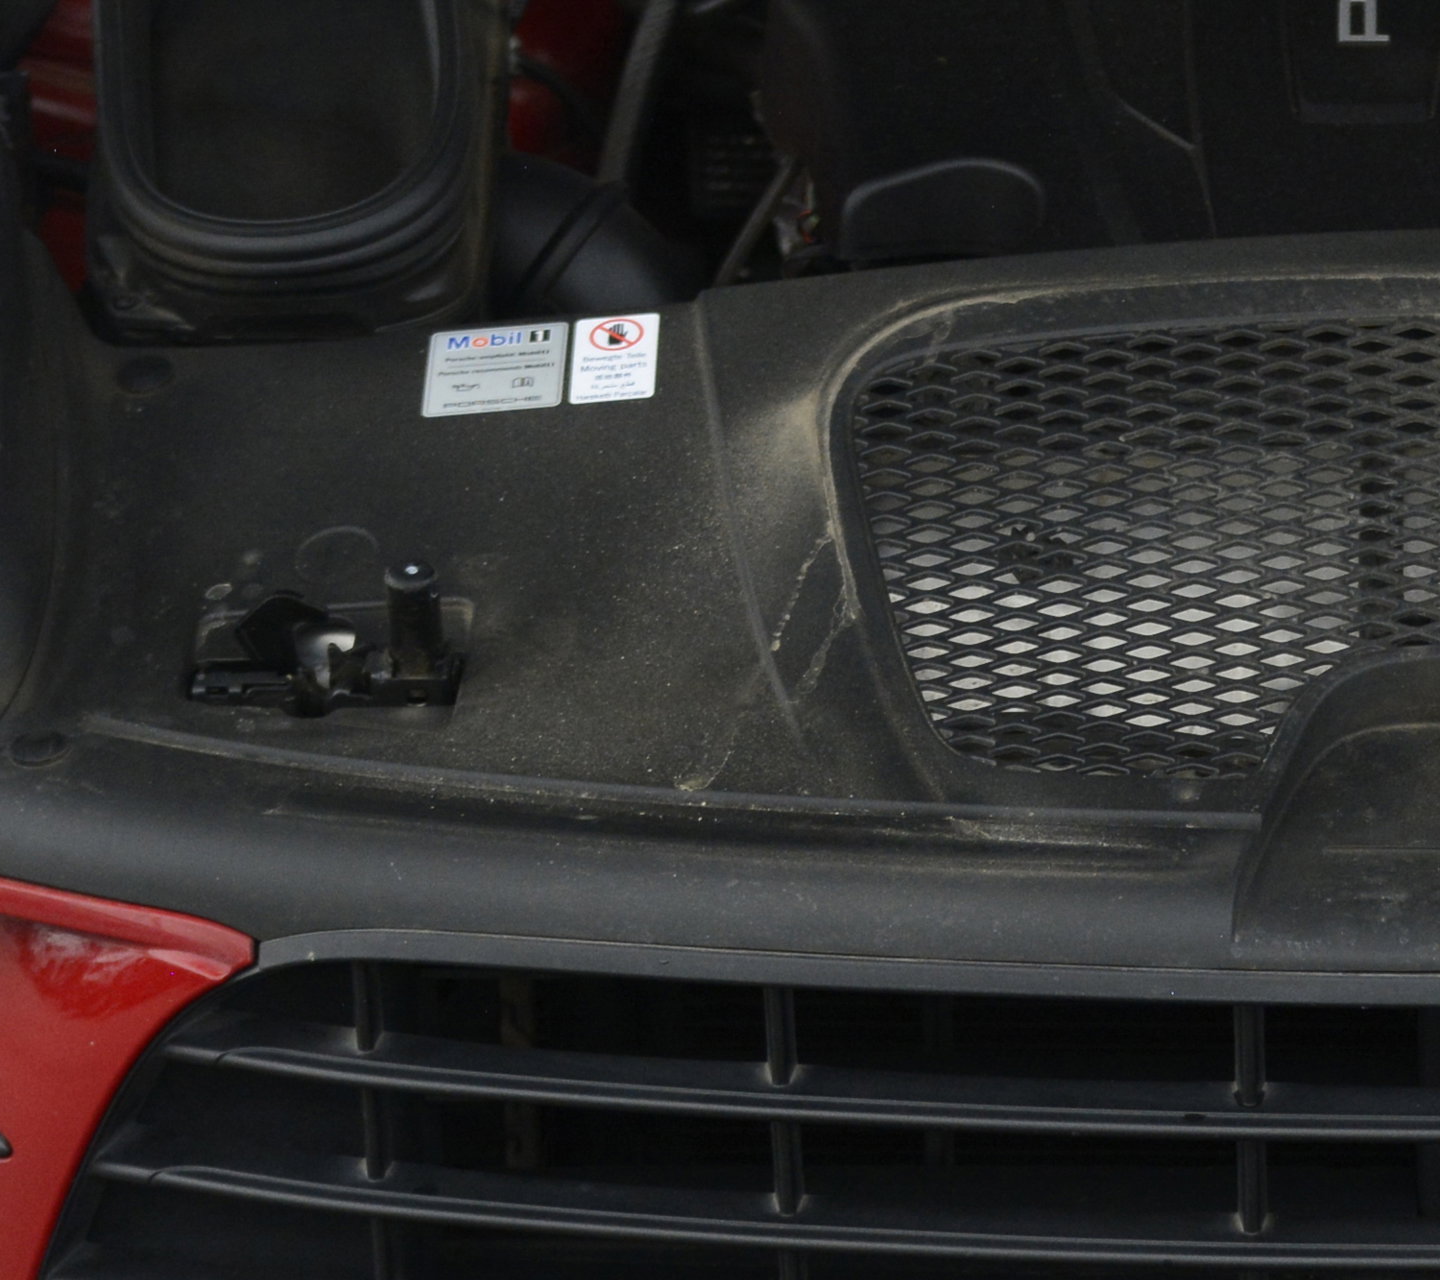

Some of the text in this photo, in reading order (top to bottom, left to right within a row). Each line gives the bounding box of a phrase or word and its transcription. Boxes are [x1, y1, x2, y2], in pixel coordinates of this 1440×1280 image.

[447, 331, 522, 350] Mobil
[579, 359, 647, 374] Moving parts
[443, 395, 542, 409] PORSCHE
